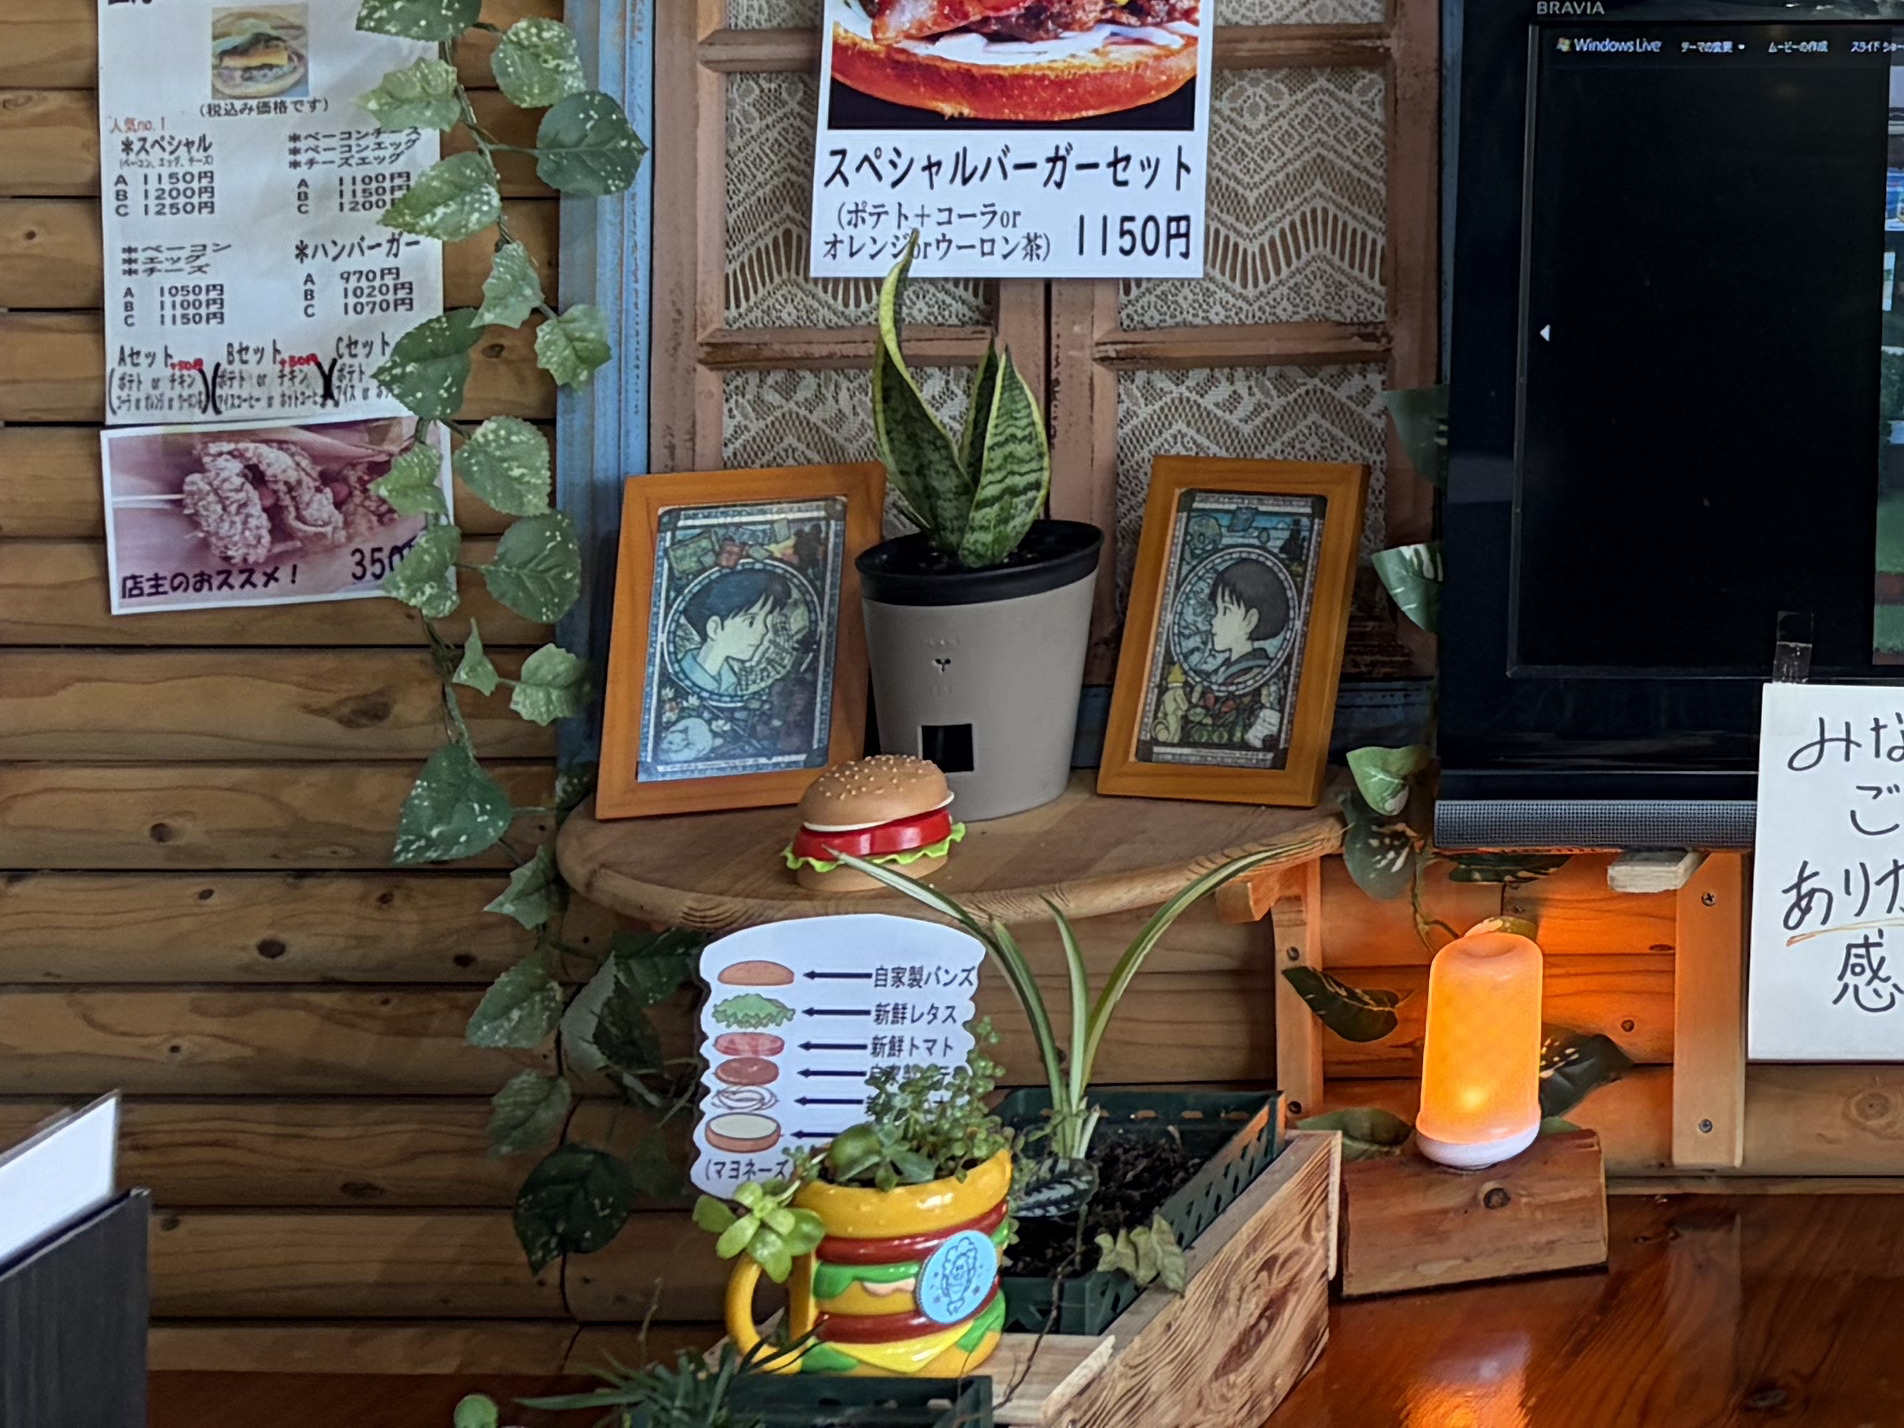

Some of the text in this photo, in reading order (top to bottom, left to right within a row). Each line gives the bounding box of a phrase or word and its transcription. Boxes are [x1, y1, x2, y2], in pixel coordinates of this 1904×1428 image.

[1536, 1, 1606, 16] BRAVIA
[1574, 37, 1634, 53] Windows
[199, 97, 329, 119] (税込み価格です)
[824, 141, 1193, 192] スペシャルバーガーセット
[143, 170, 215, 186] 1150円
[143, 186, 215, 201] 1200円
[143, 201, 215, 217] 1250円
[1077, 213, 1193, 261] 1150円
[341, 267, 400, 283] 970円
[159, 284, 224, 298] 1050円
[343, 282, 413, 300] 1020円
[343, 297, 414, 316] 1070円
[121, 564, 298, 599] 店主のおススメ!
[873, 964, 977, 990] 自家製バンズ
[873, 1002, 958, 1026] 新鮮レタス
[870, 1035, 955, 1058] 新鮮トマト
